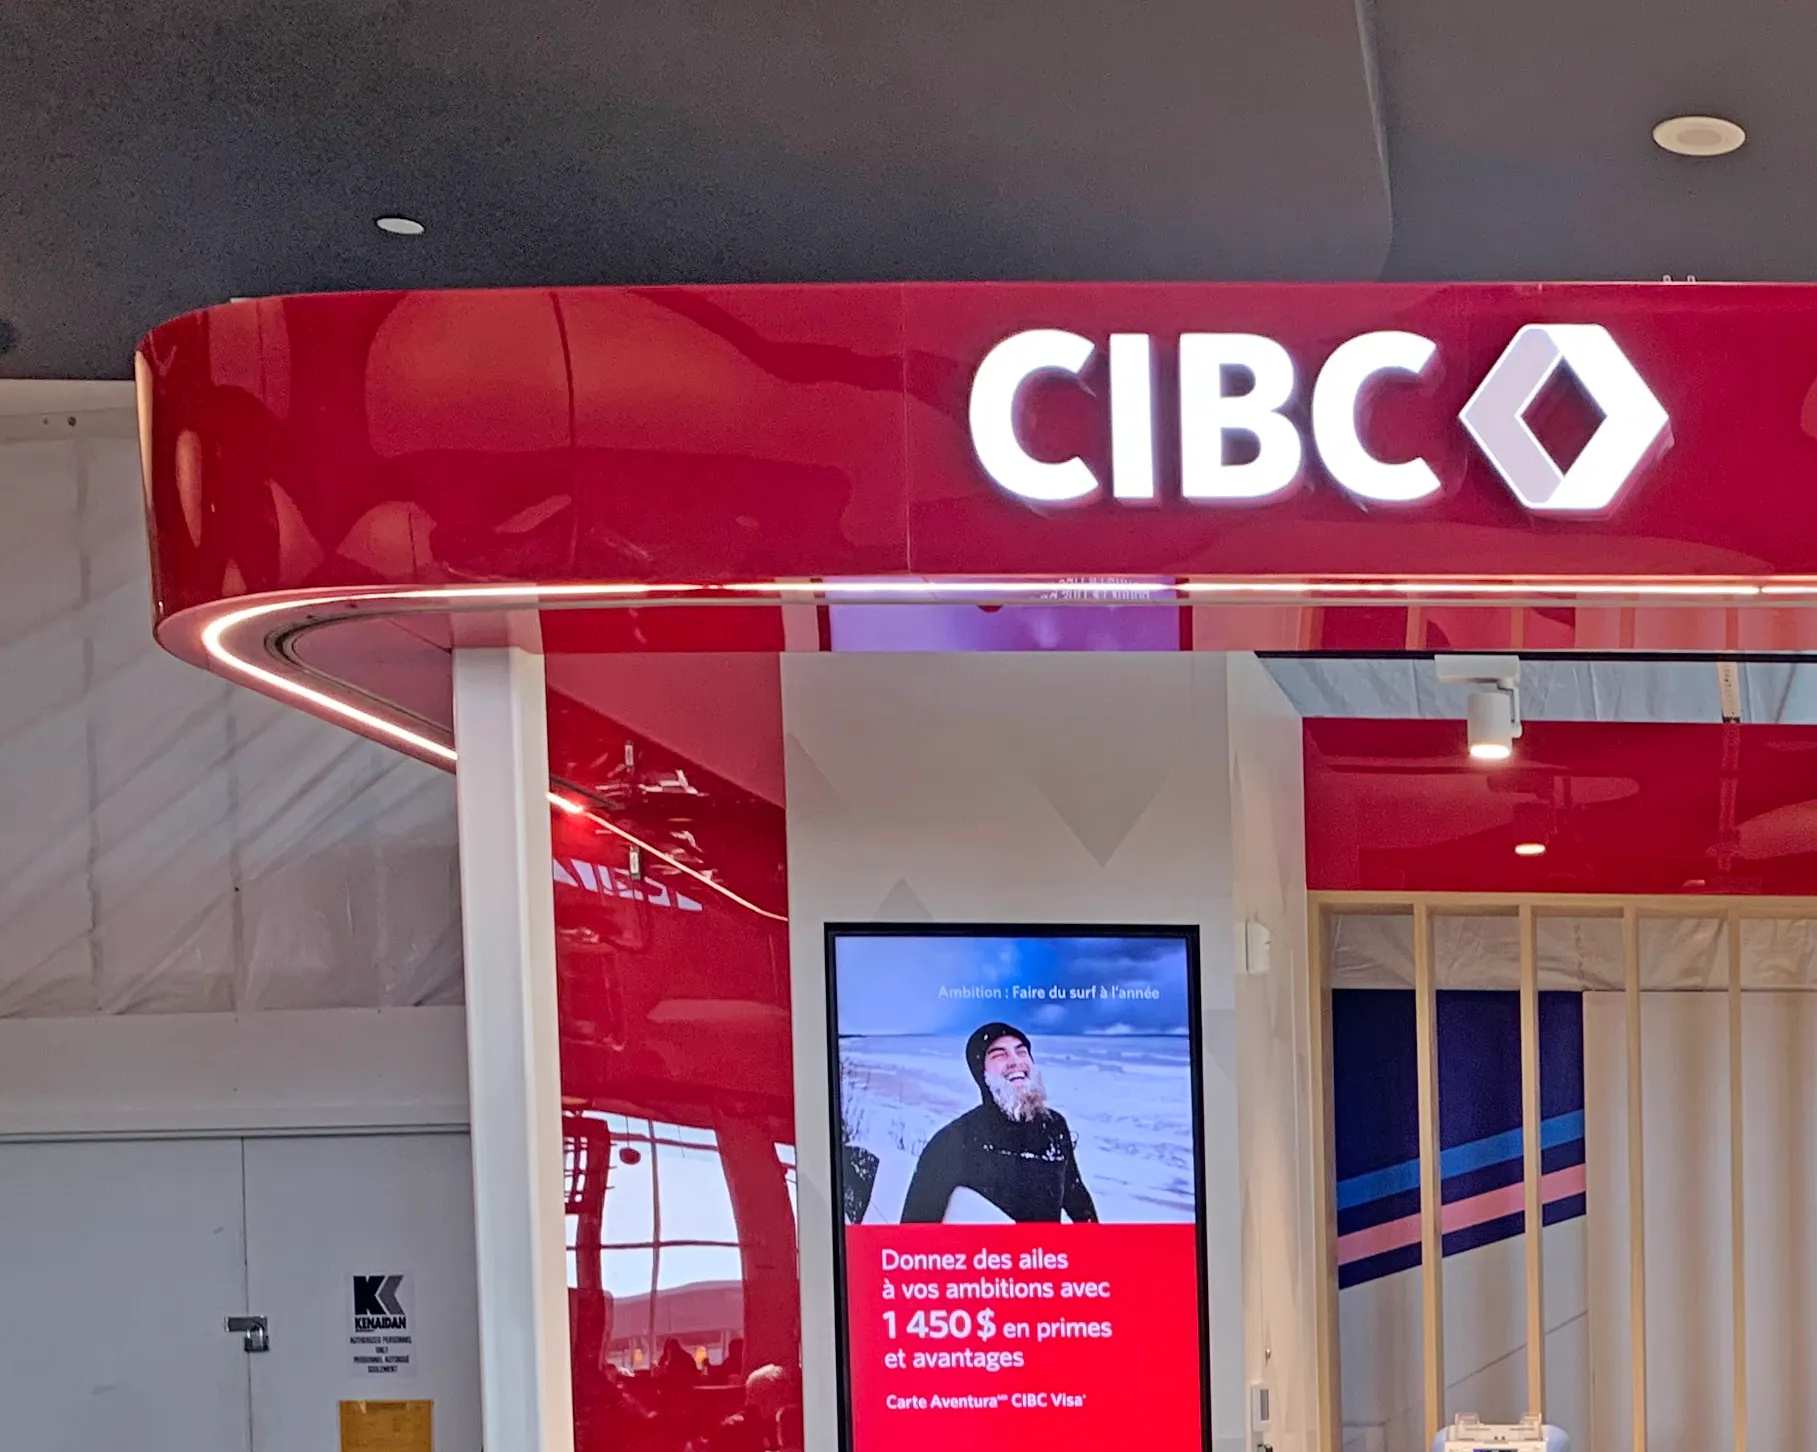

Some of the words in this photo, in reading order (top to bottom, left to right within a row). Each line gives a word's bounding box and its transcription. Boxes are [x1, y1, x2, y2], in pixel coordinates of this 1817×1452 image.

[969, 329, 1441, 505] CIBC
[938, 985, 1001, 999] Ambition
[1012, 985, 1045, 999] Faire
[1049, 985, 1066, 999] du
[1069, 985, 1096, 999] surf
[1100, 985, 1108, 999] à
[1111, 985, 1160, 999] l'année
[881, 1249, 967, 1271] Donnez
[974, 1249, 1012, 1271] des
[1018, 1247, 1069, 1271] ailes
[882, 1278, 895, 1300] à
[901, 1281, 939, 1300] vos
[946, 1276, 1055, 1300] ambitions
[1060, 1280, 1111, 1299] avec
[355, 1316, 406, 1329] KENAIDAN
[906, 1310, 972, 1339] 450
[977, 1307, 997, 1342] $
[1003, 1321, 1031, 1339] en
[1037, 1317, 1113, 1344] primes
[884, 1349, 906, 1369] et
[912, 1349, 1025, 1373] avantages
[886, 1394, 927, 1409] Carte
[1011, 1393, 1047, 1408] CIBC
